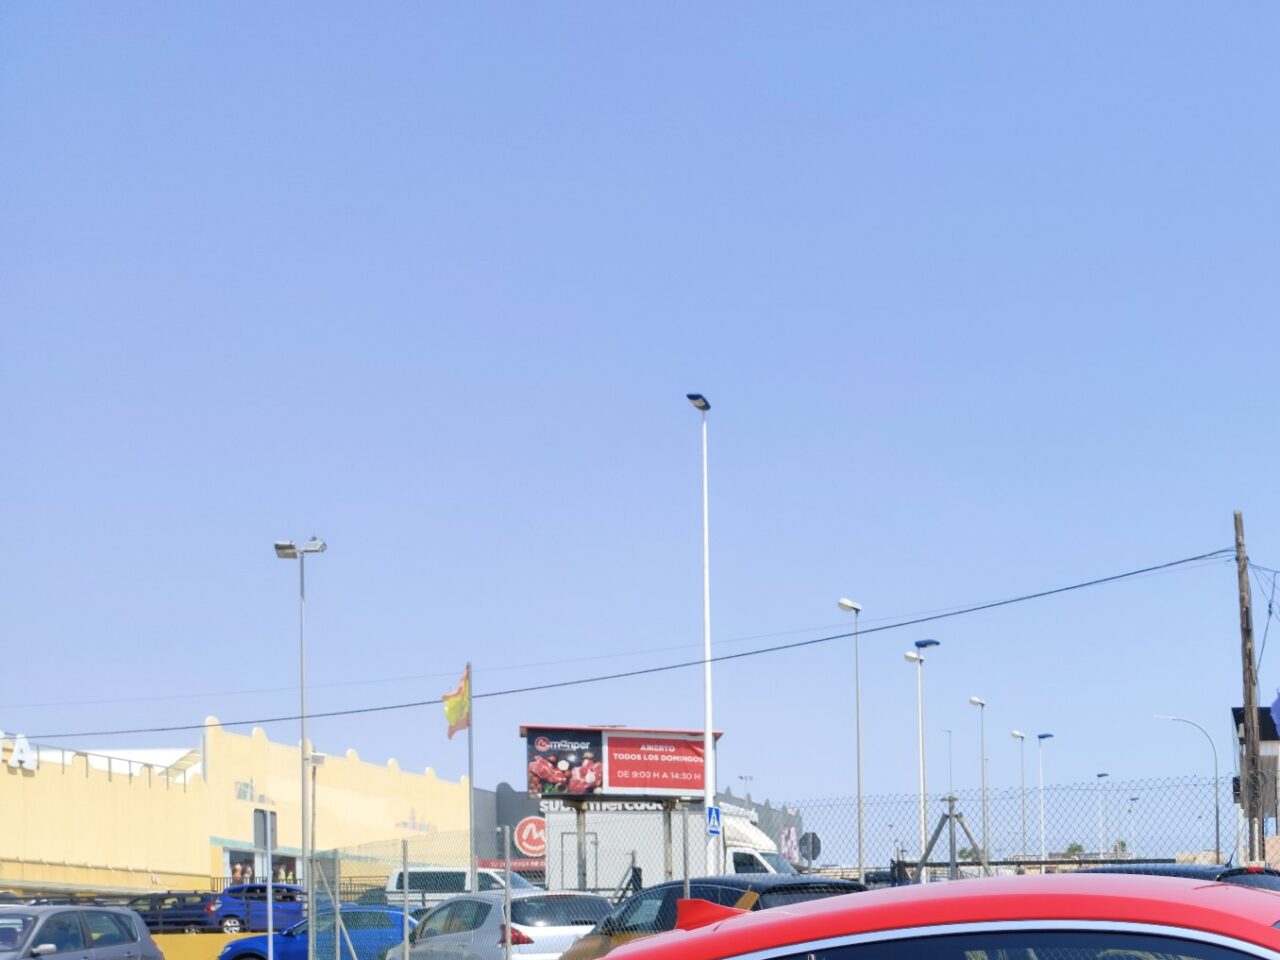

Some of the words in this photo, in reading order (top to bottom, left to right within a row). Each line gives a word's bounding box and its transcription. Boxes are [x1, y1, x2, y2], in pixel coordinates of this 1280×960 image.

[612, 752, 642, 761] TODOS
[643, 753, 659, 761] LOS
[660, 754, 704, 763] DOMINGOS
[617, 770, 630, 778] DE
[632, 770, 651, 779] 9:00
[653, 771, 660, 779] H
[662, 771, 669, 779] A
[670, 771, 692, 780] 14:30
